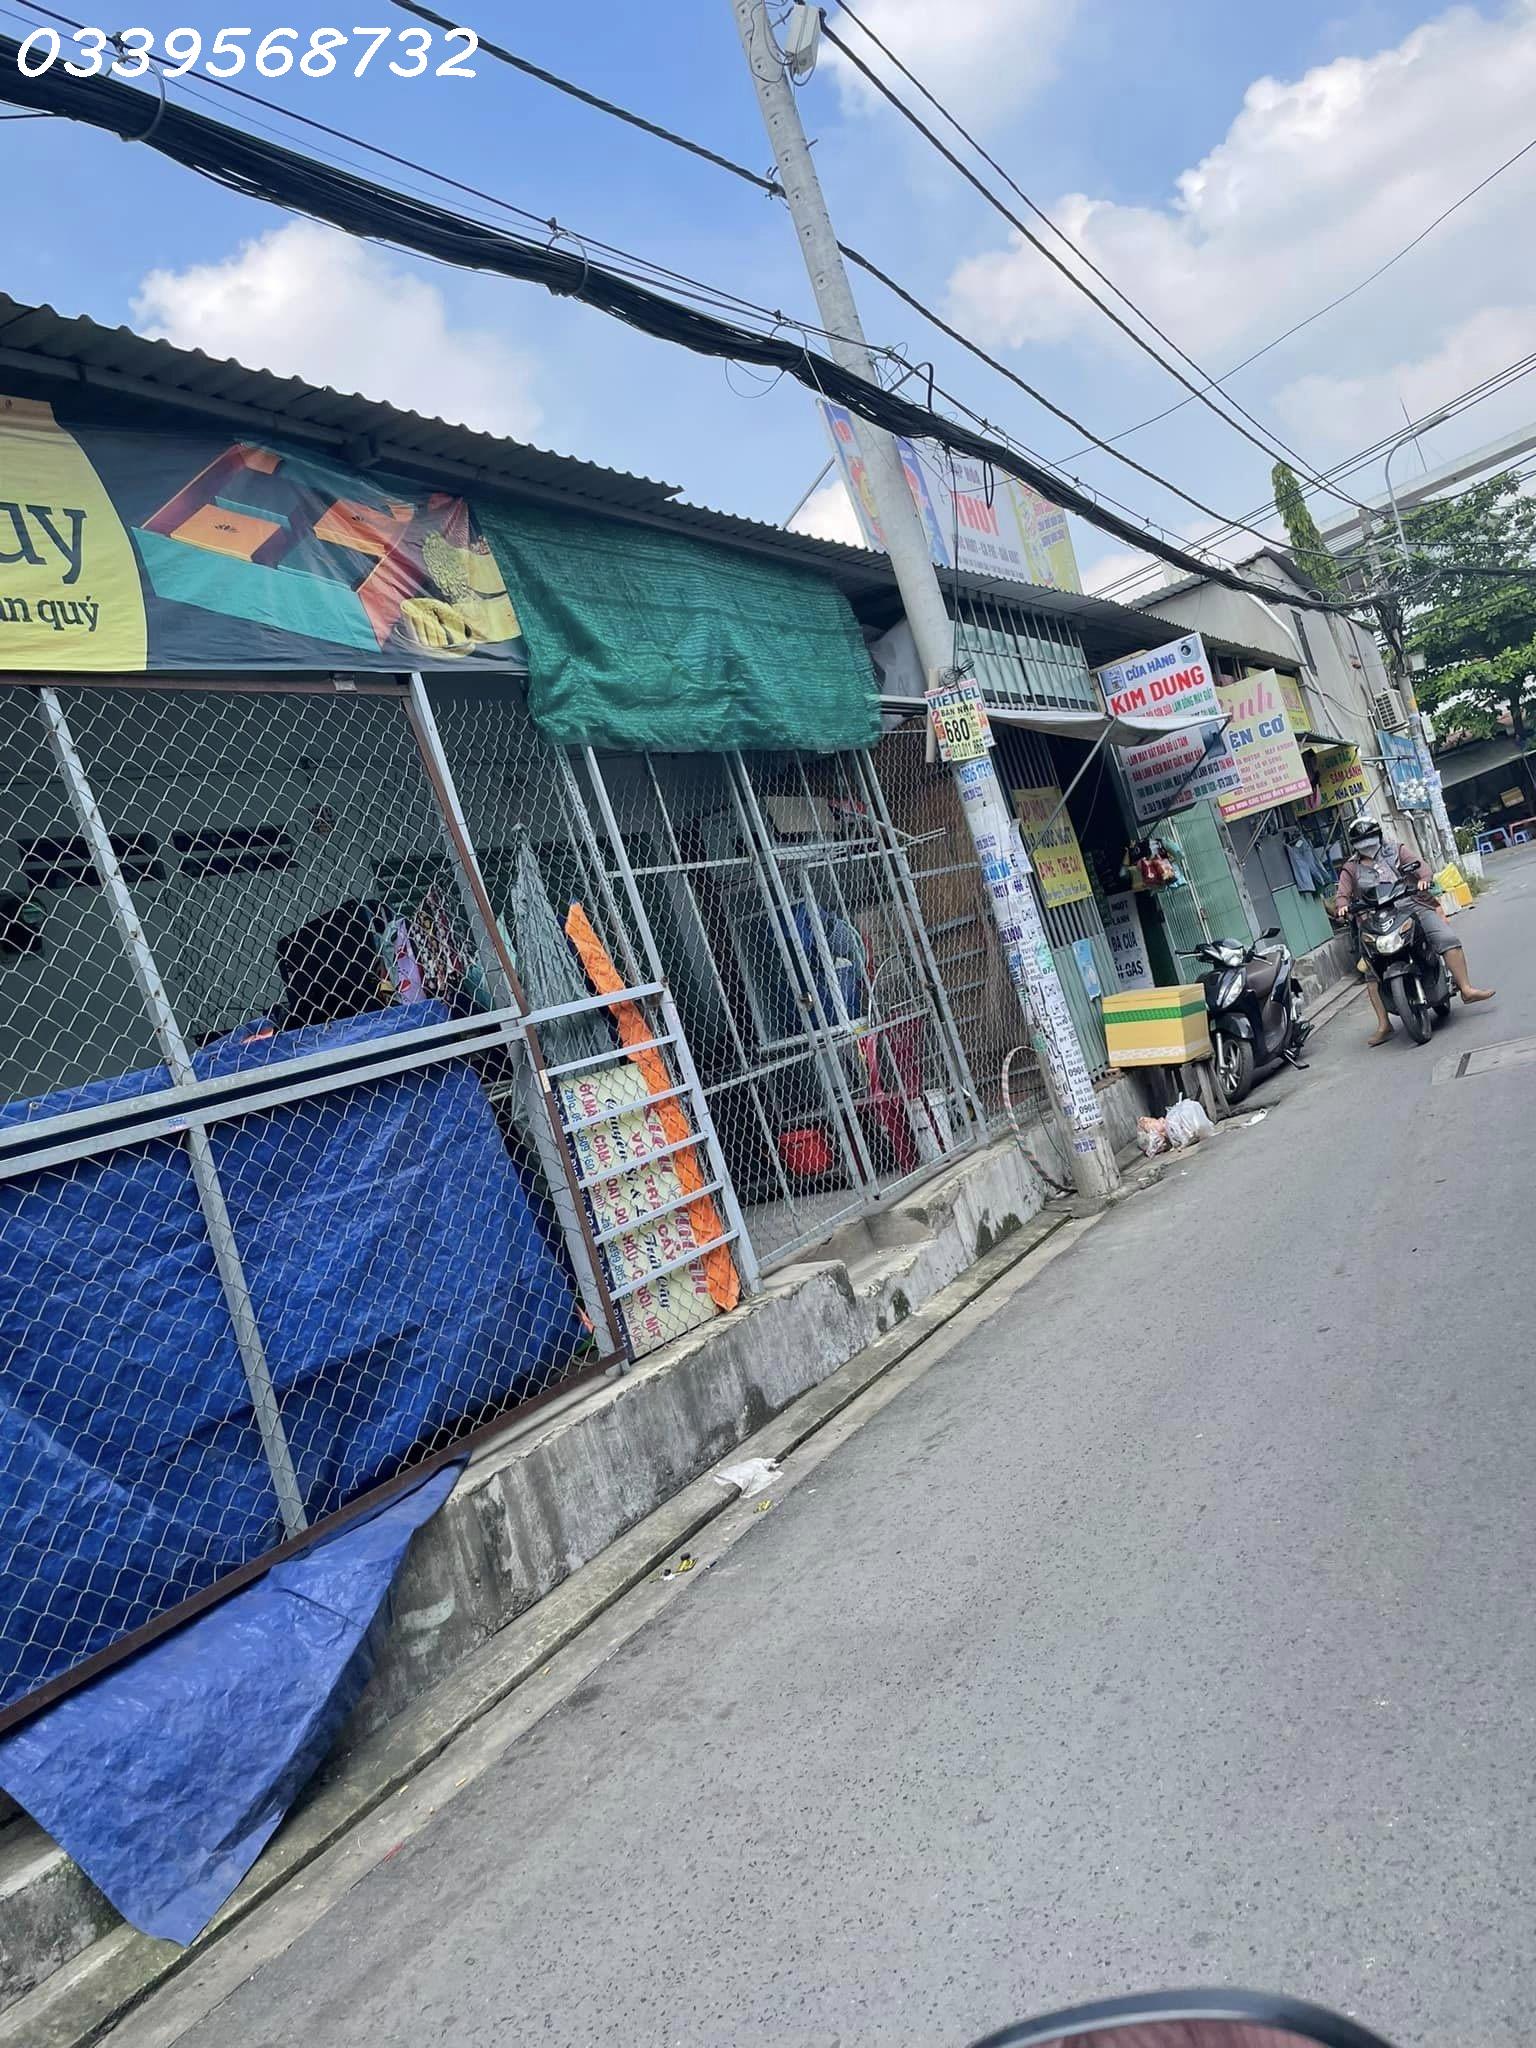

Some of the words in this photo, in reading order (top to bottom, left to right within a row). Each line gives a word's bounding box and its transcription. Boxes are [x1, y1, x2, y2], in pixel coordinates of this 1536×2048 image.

[37, 596, 99, 631] quý
[1147, 653, 1176, 672] HÀNG
[928, 687, 979, 710] VIETTEL
[1110, 687, 1147, 716] KIM
[1149, 665, 1205, 702] DUNG
[944, 718, 970, 743] 680
[1229, 728, 1254, 752] ỆN
[1259, 713, 1285, 738] CƠ
[1125, 961, 1143, 977] GAS
[594, 1134, 611, 1161] CAM
